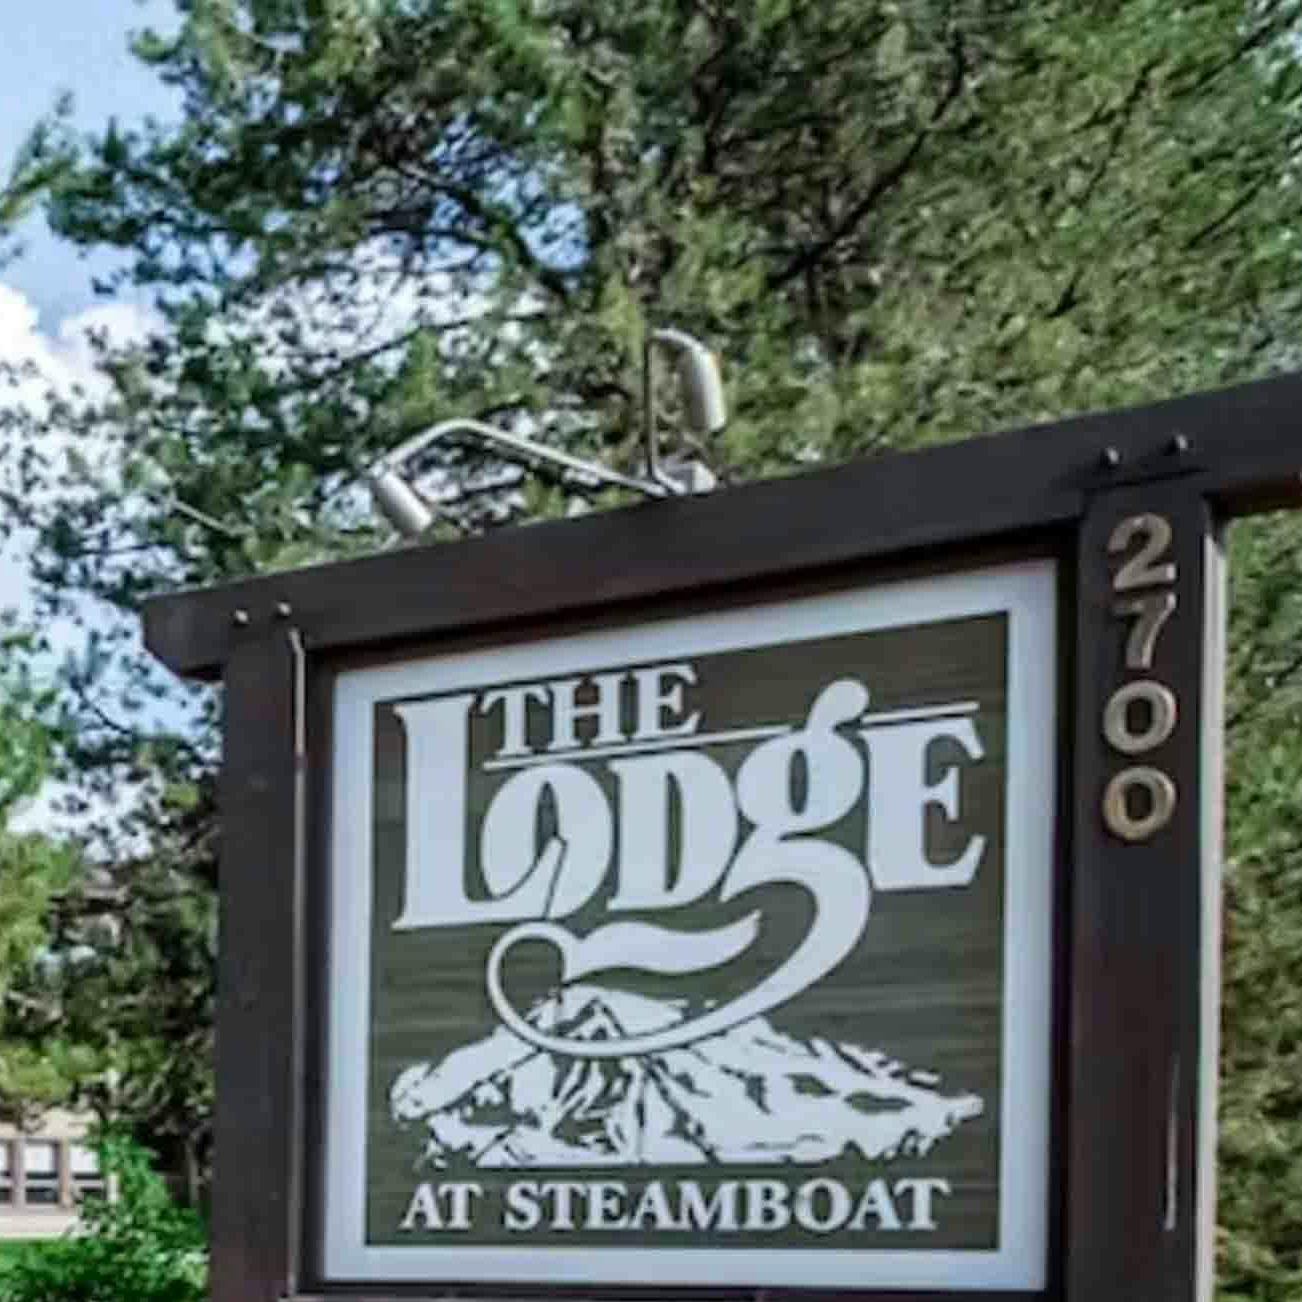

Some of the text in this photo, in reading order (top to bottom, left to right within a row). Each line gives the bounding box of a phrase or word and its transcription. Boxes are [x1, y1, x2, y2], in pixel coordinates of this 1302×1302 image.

[484, 663, 700, 758] THE
[1102, 512, 1178, 842] 2700
[399, 1176, 953, 1233] AT STEAMBOAT
